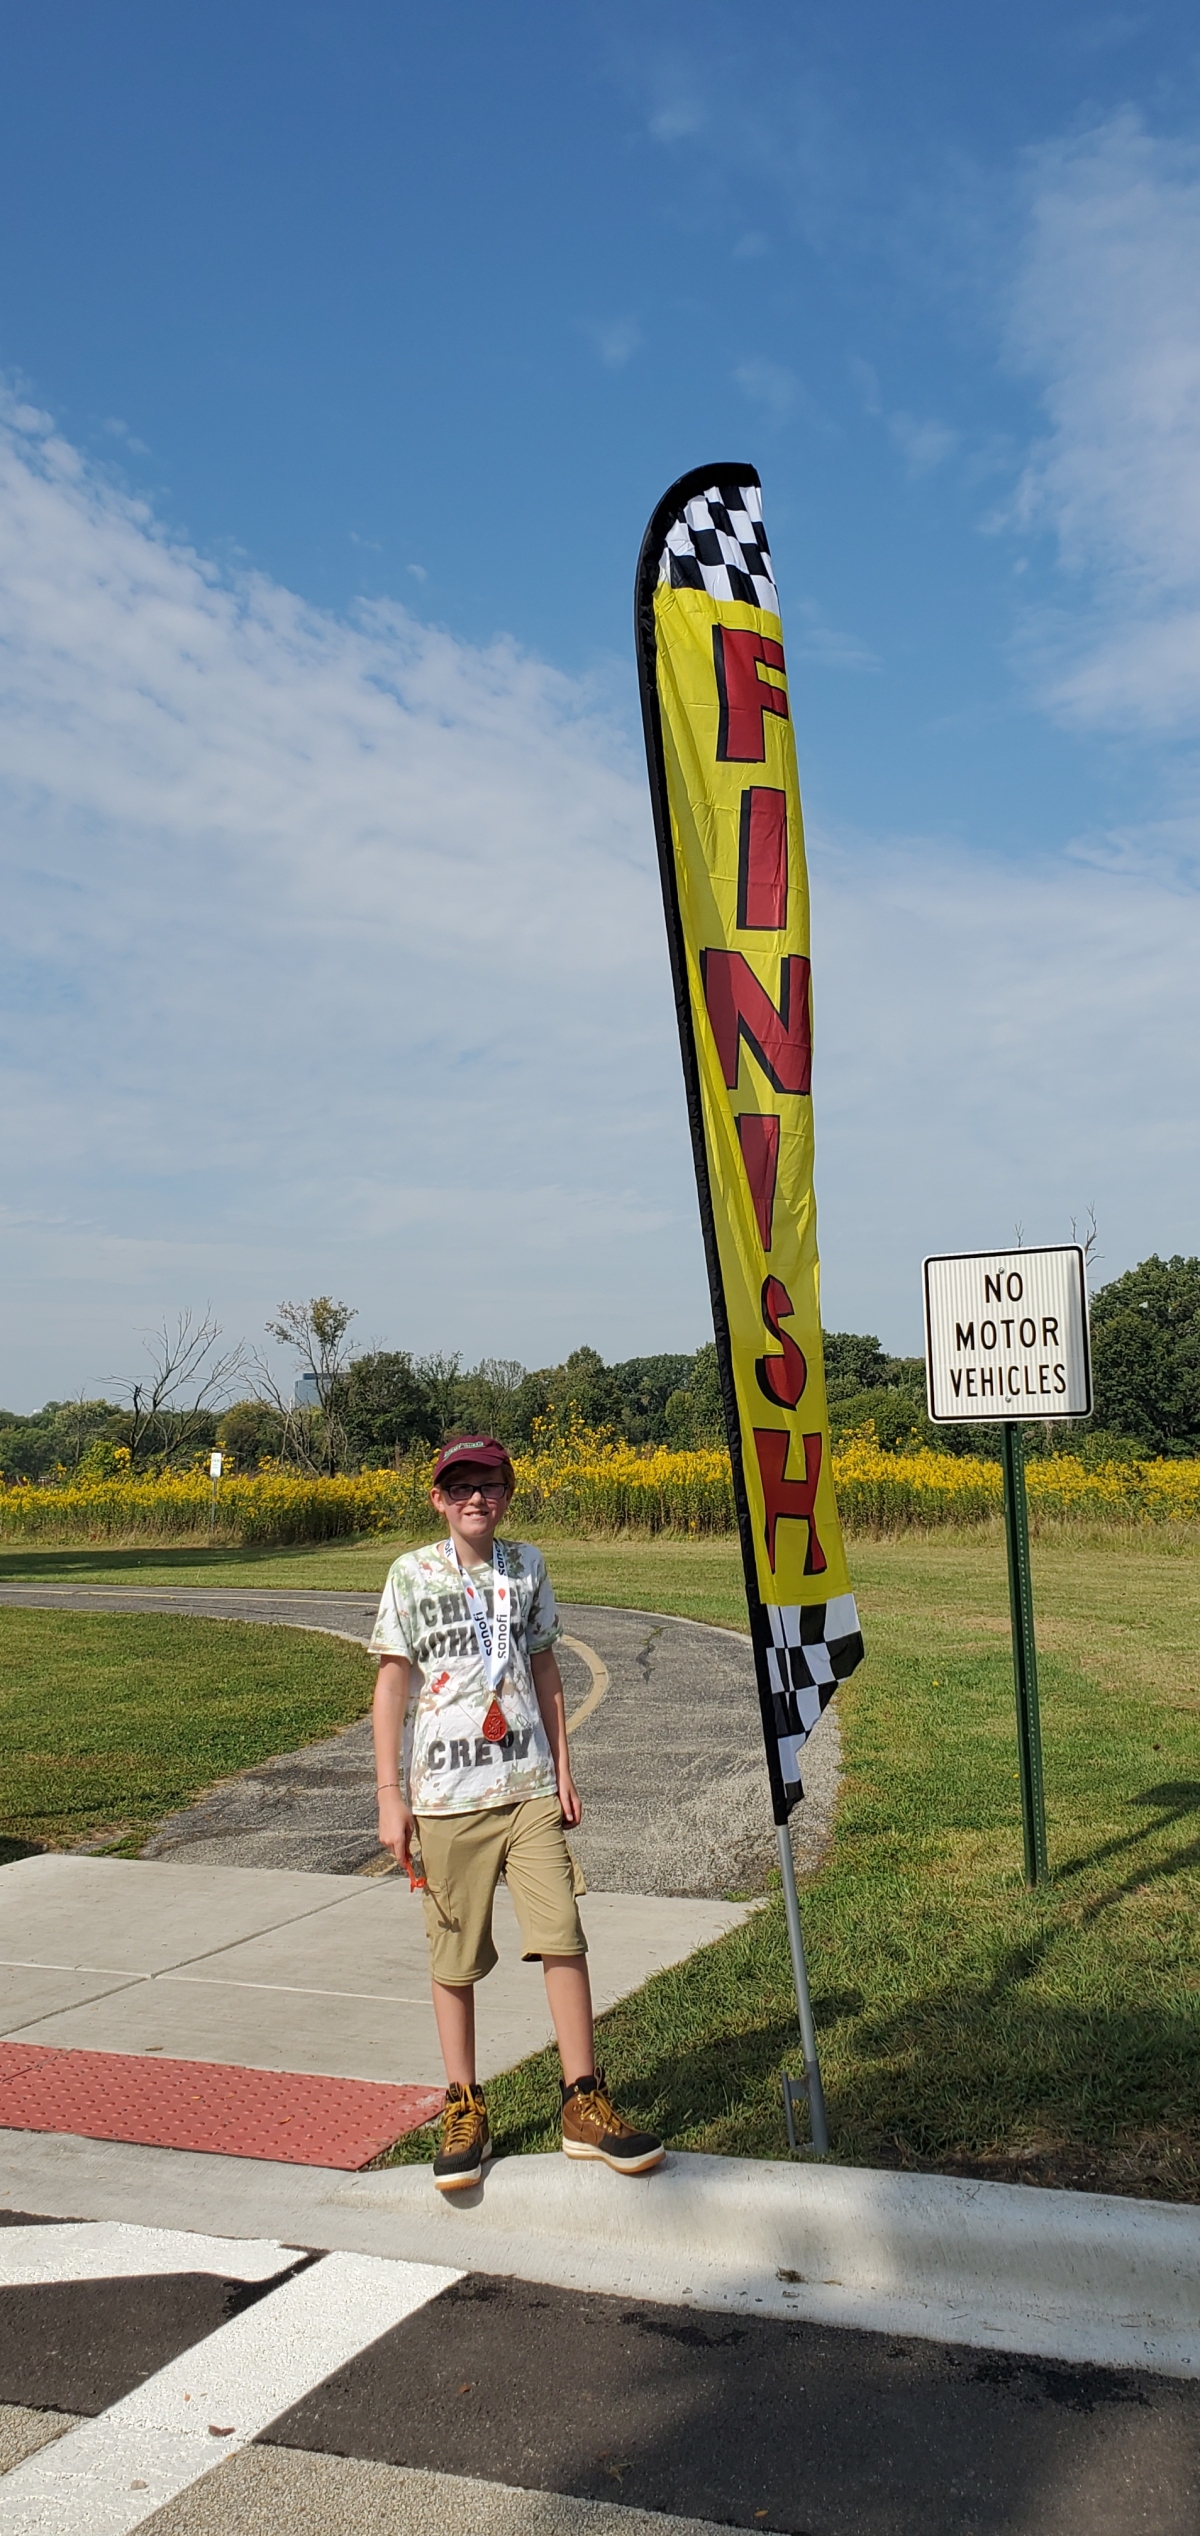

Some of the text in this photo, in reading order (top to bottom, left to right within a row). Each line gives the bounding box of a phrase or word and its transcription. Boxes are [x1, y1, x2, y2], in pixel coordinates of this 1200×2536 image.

[701, 624, 827, 1576] FINISH
[984, 1271, 1024, 1304] NO
[955, 1316, 1060, 1351] MOTOR
[949, 1363, 1067, 1398] VEHICLES
[496, 1614, 508, 1659] sanofi
[427, 1728, 533, 1771] CREW
